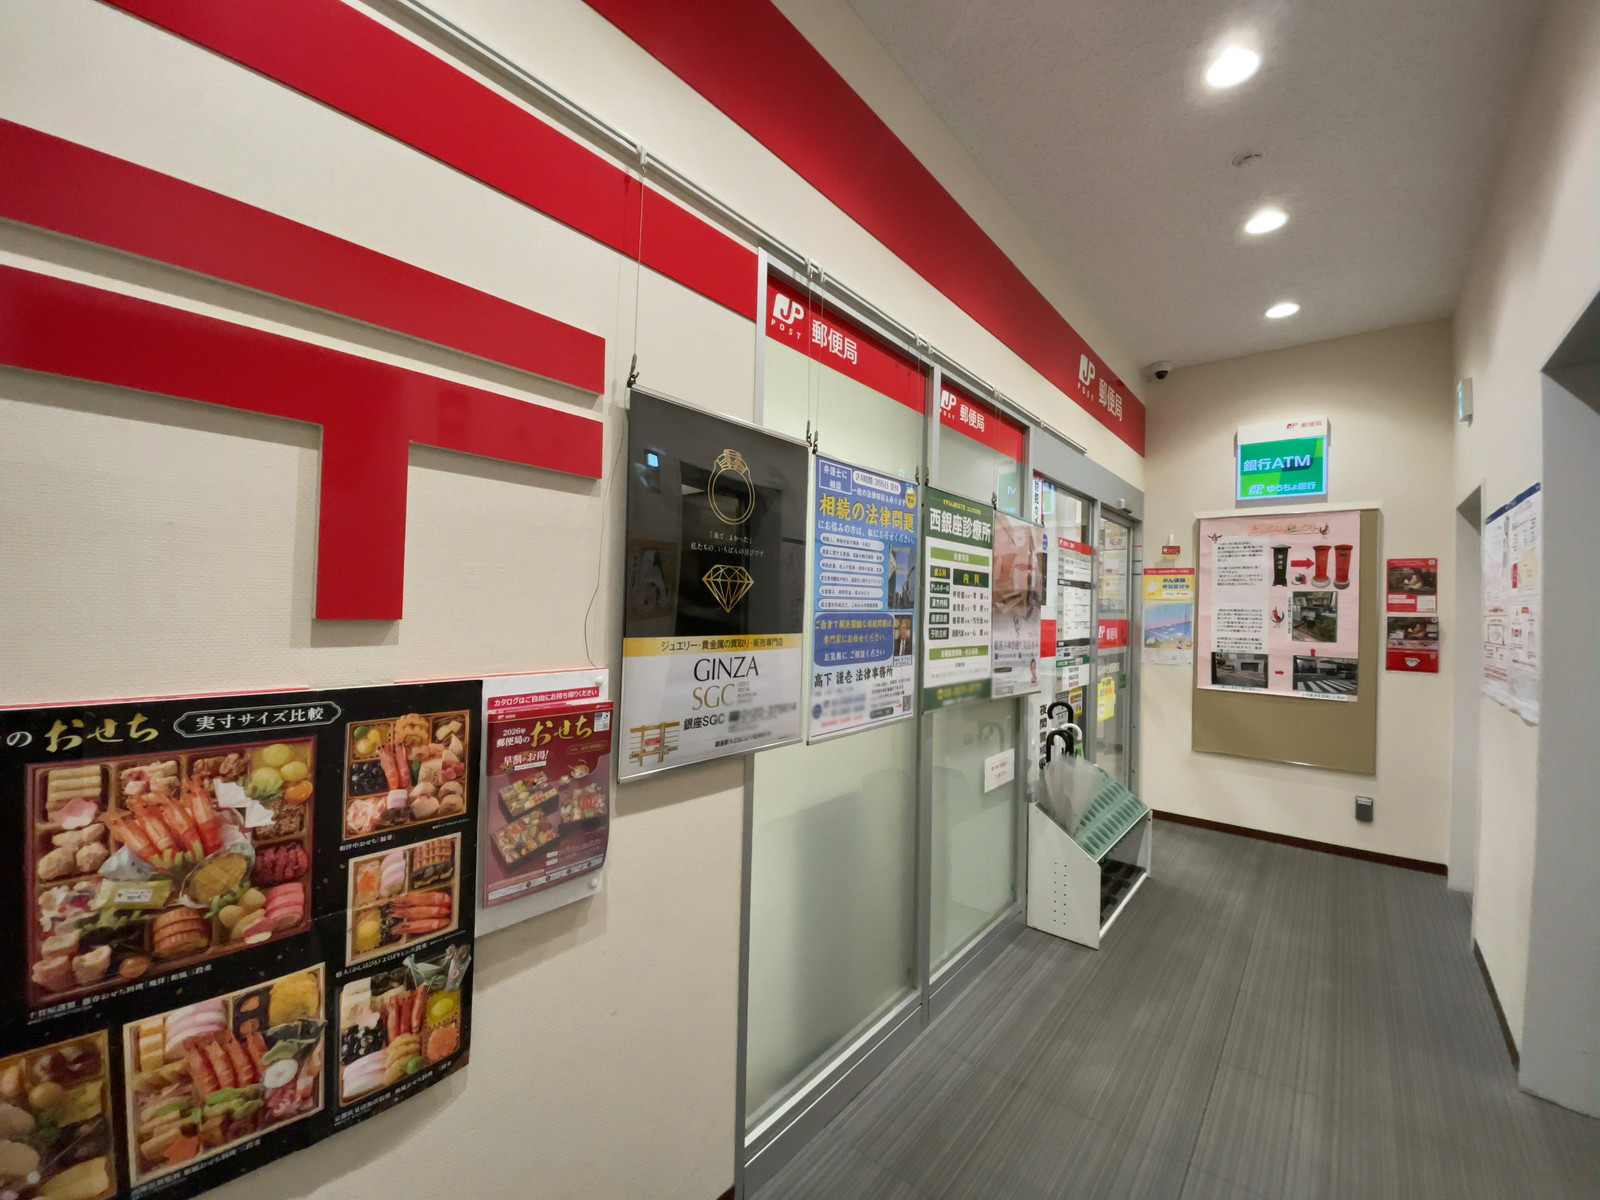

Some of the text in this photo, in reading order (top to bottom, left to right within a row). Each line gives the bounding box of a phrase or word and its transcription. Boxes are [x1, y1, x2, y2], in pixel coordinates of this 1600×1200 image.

[770, 318, 802, 340] POST
[811, 319, 858, 365] 郵便局
[1098, 377, 1123, 422] 郵便局
[960, 403, 985, 432] 郵便局
[823, 464, 848, 479] 弁護士に
[1243, 454, 1311, 472] 銀行ATM
[829, 480, 842, 491] 相談
[855, 472, 873, 484] 24時間
[873, 477, 889, 490] 365日
[1267, 481, 1316, 492] ゆうちょ銀行
[819, 493, 914, 533] 相続の法律問題
[929, 507, 991, 544] 西銀座診療所
[693, 655, 759, 682] GINZA
[814, 672, 832, 687] 高下
[855, 665, 893, 682] 法律事務所
[494, 689, 598, 707] カタログはご自由にお持ち帰りください
[692, 683, 736, 711] SGC
[196, 707, 324, 731] 実寸サイズ比較
[683, 713, 725, 731] 銀座SGC
[45, 712, 159, 753] おせち
[496, 715, 592, 748] 郵便局の おせち
